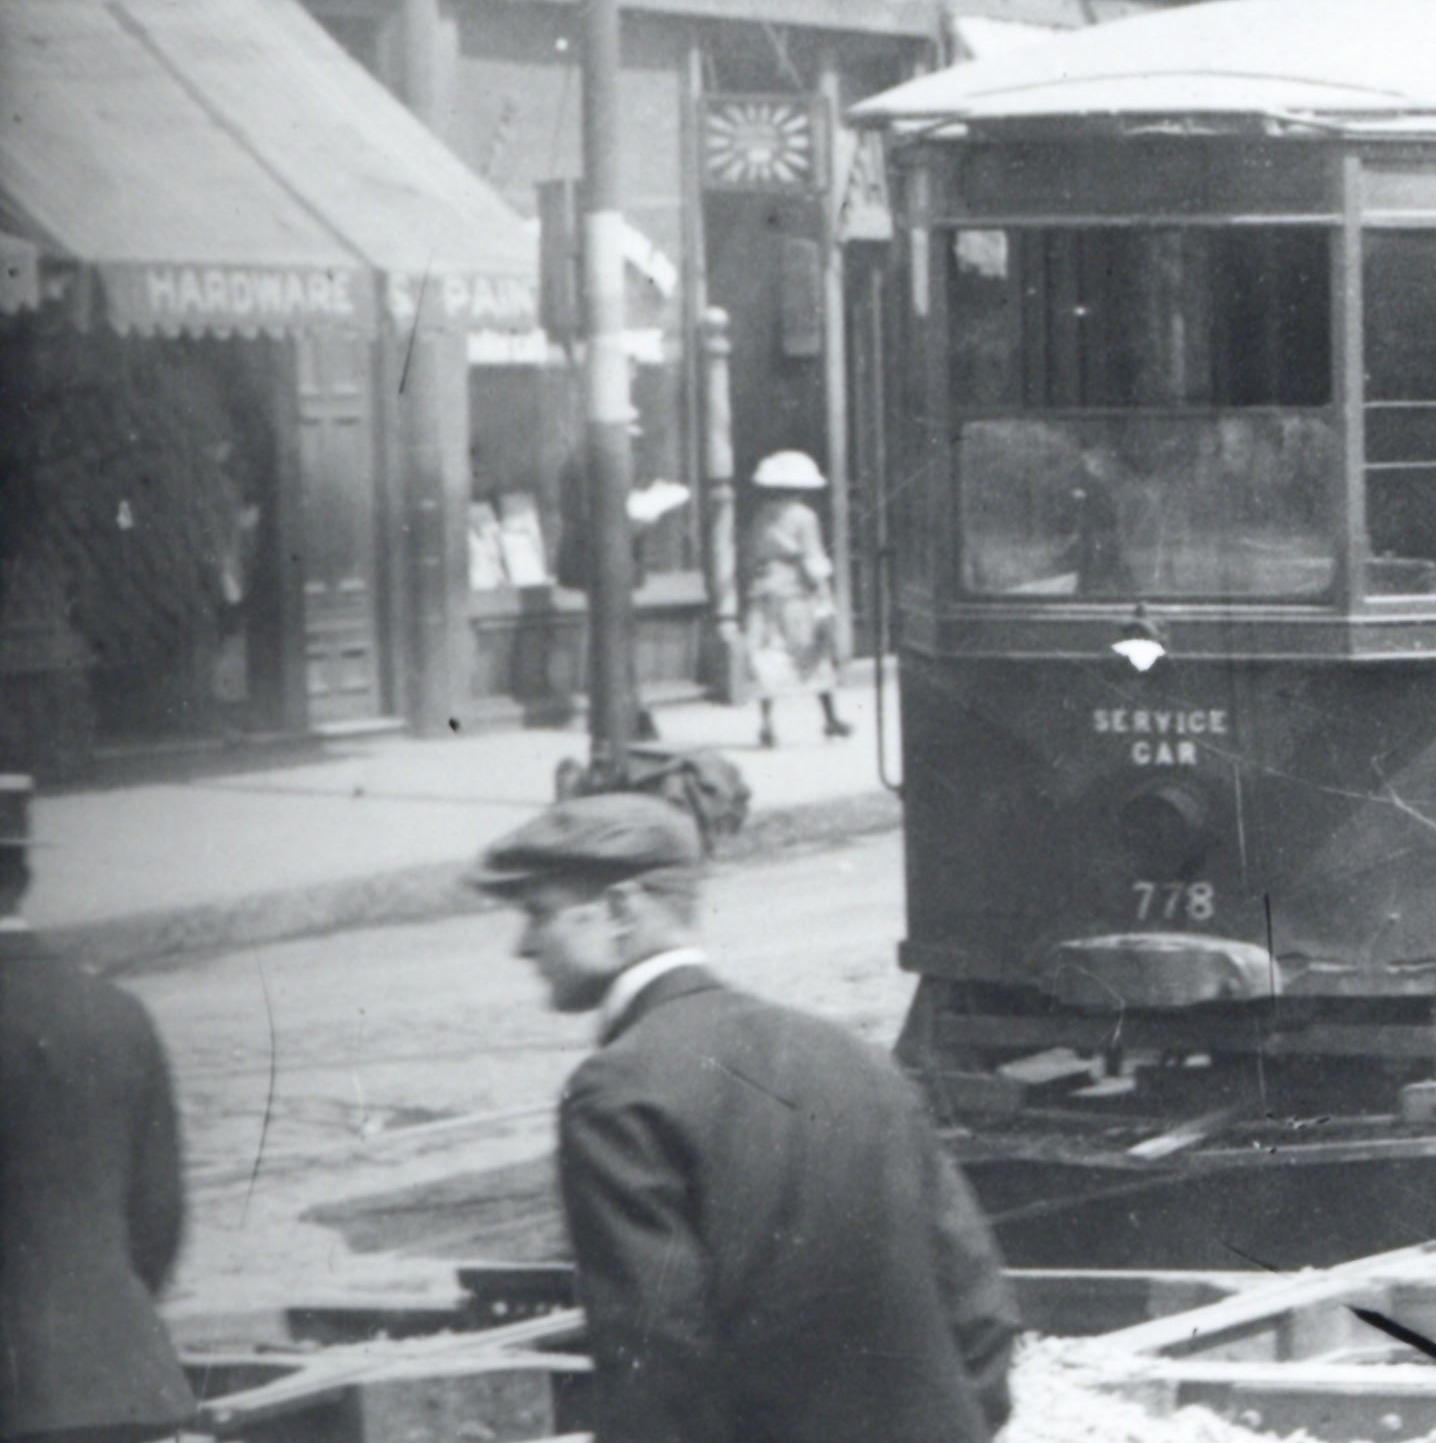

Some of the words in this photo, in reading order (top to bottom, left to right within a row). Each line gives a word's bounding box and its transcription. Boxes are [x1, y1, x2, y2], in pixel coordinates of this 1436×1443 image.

[145, 267, 353, 314] HARDWARE
[1093, 708, 1228, 735] SERVICE
[1131, 740, 1198, 766] CAR
[1132, 880, 1215, 922] 778
